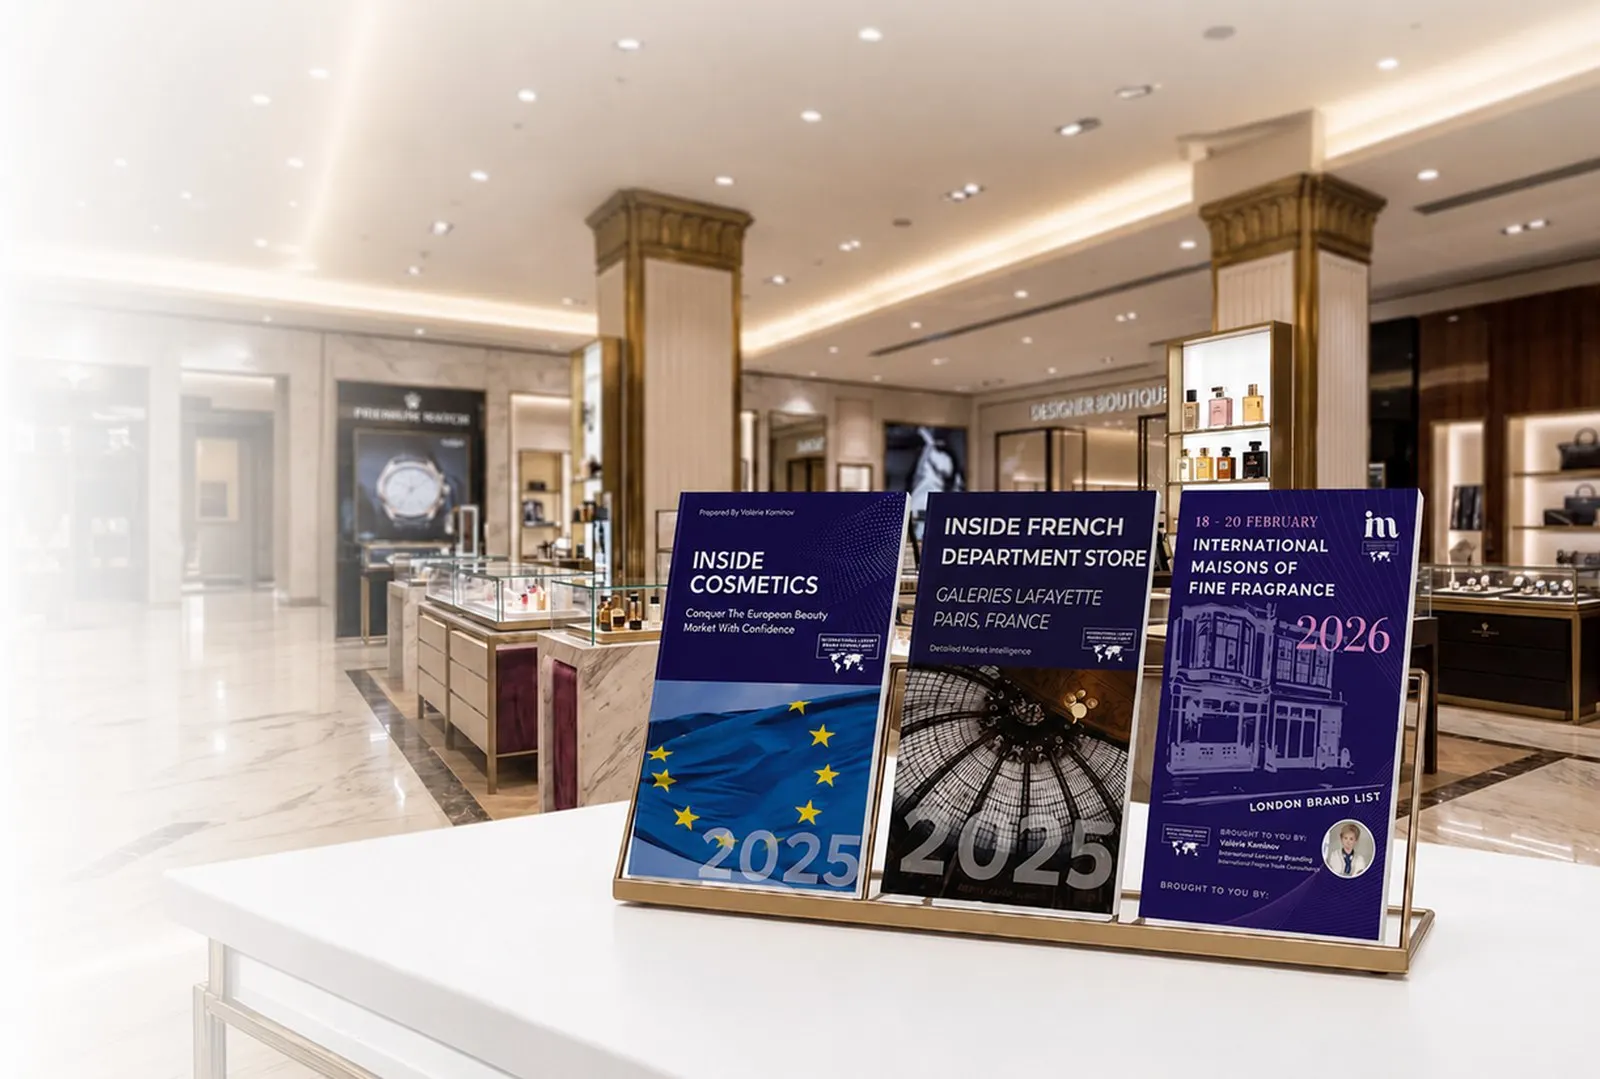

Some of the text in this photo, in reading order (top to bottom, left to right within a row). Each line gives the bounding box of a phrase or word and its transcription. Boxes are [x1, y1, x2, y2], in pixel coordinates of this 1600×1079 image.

[730, 508, 740, 518] By
[1195, 515, 1210, 528] 18
[1224, 515, 1242, 528] 20
[1246, 516, 1318, 529] FEBRUARY
[944, 517, 1124, 536] INSIDE FRENCH
[1364, 510, 1400, 538] im
[1193, 538, 1328, 553] INTERNATIONAL
[693, 551, 765, 570] INSIDE
[941, 548, 1147, 568] DEPARTMENT STORE
[1191, 560, 1298, 575] MAISONS OF
[690, 575, 819, 595] COSMETICS
[1189, 581, 1335, 597] FINE FRAGRANCE
[936, 586, 1103, 606] GALERIES LAFAYETTE
[685, 607, 829, 622] Conquer The European Beauty
[933, 611, 1051, 631] PARIS, FRANCE
[683, 622, 796, 634] Market With Confidence
[1296, 614, 1391, 654] 2026
[929, 644, 961, 653] Detailed
[962, 645, 988, 654] Market
[1250, 791, 1381, 812] LONDON BRAND LIST
[1220, 828, 1259, 838] BROUGHT
[1262, 831, 1273, 840] TO
[1274, 833, 1292, 841] YOU
[698, 827, 861, 887] 2025
[900, 808, 1115, 890] 2025
[1160, 880, 1270, 900] BROUGHT TO YOU BY:
